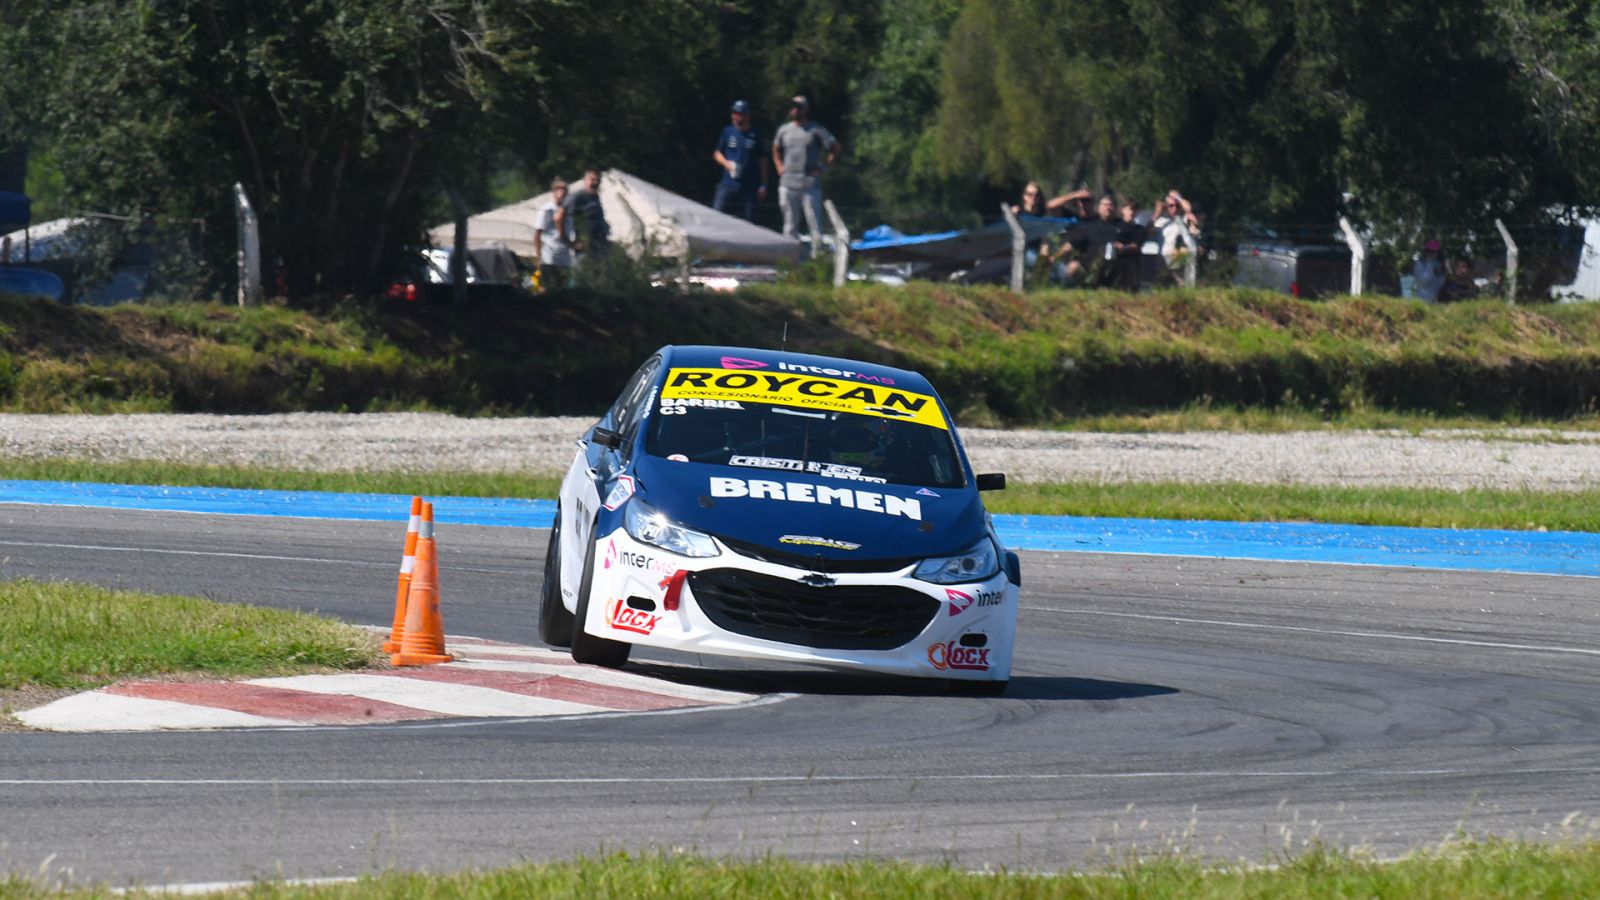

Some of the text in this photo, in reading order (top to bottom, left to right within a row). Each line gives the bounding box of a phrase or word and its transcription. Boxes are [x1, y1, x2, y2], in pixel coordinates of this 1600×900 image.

[778, 361, 896, 386] interMS
[670, 372, 928, 412] ROYCAN
[677, 389, 854, 410] CONCESIONARIO OFICIAL
[659, 405, 688, 416] C3
[709, 476, 922, 521] BREMEN
